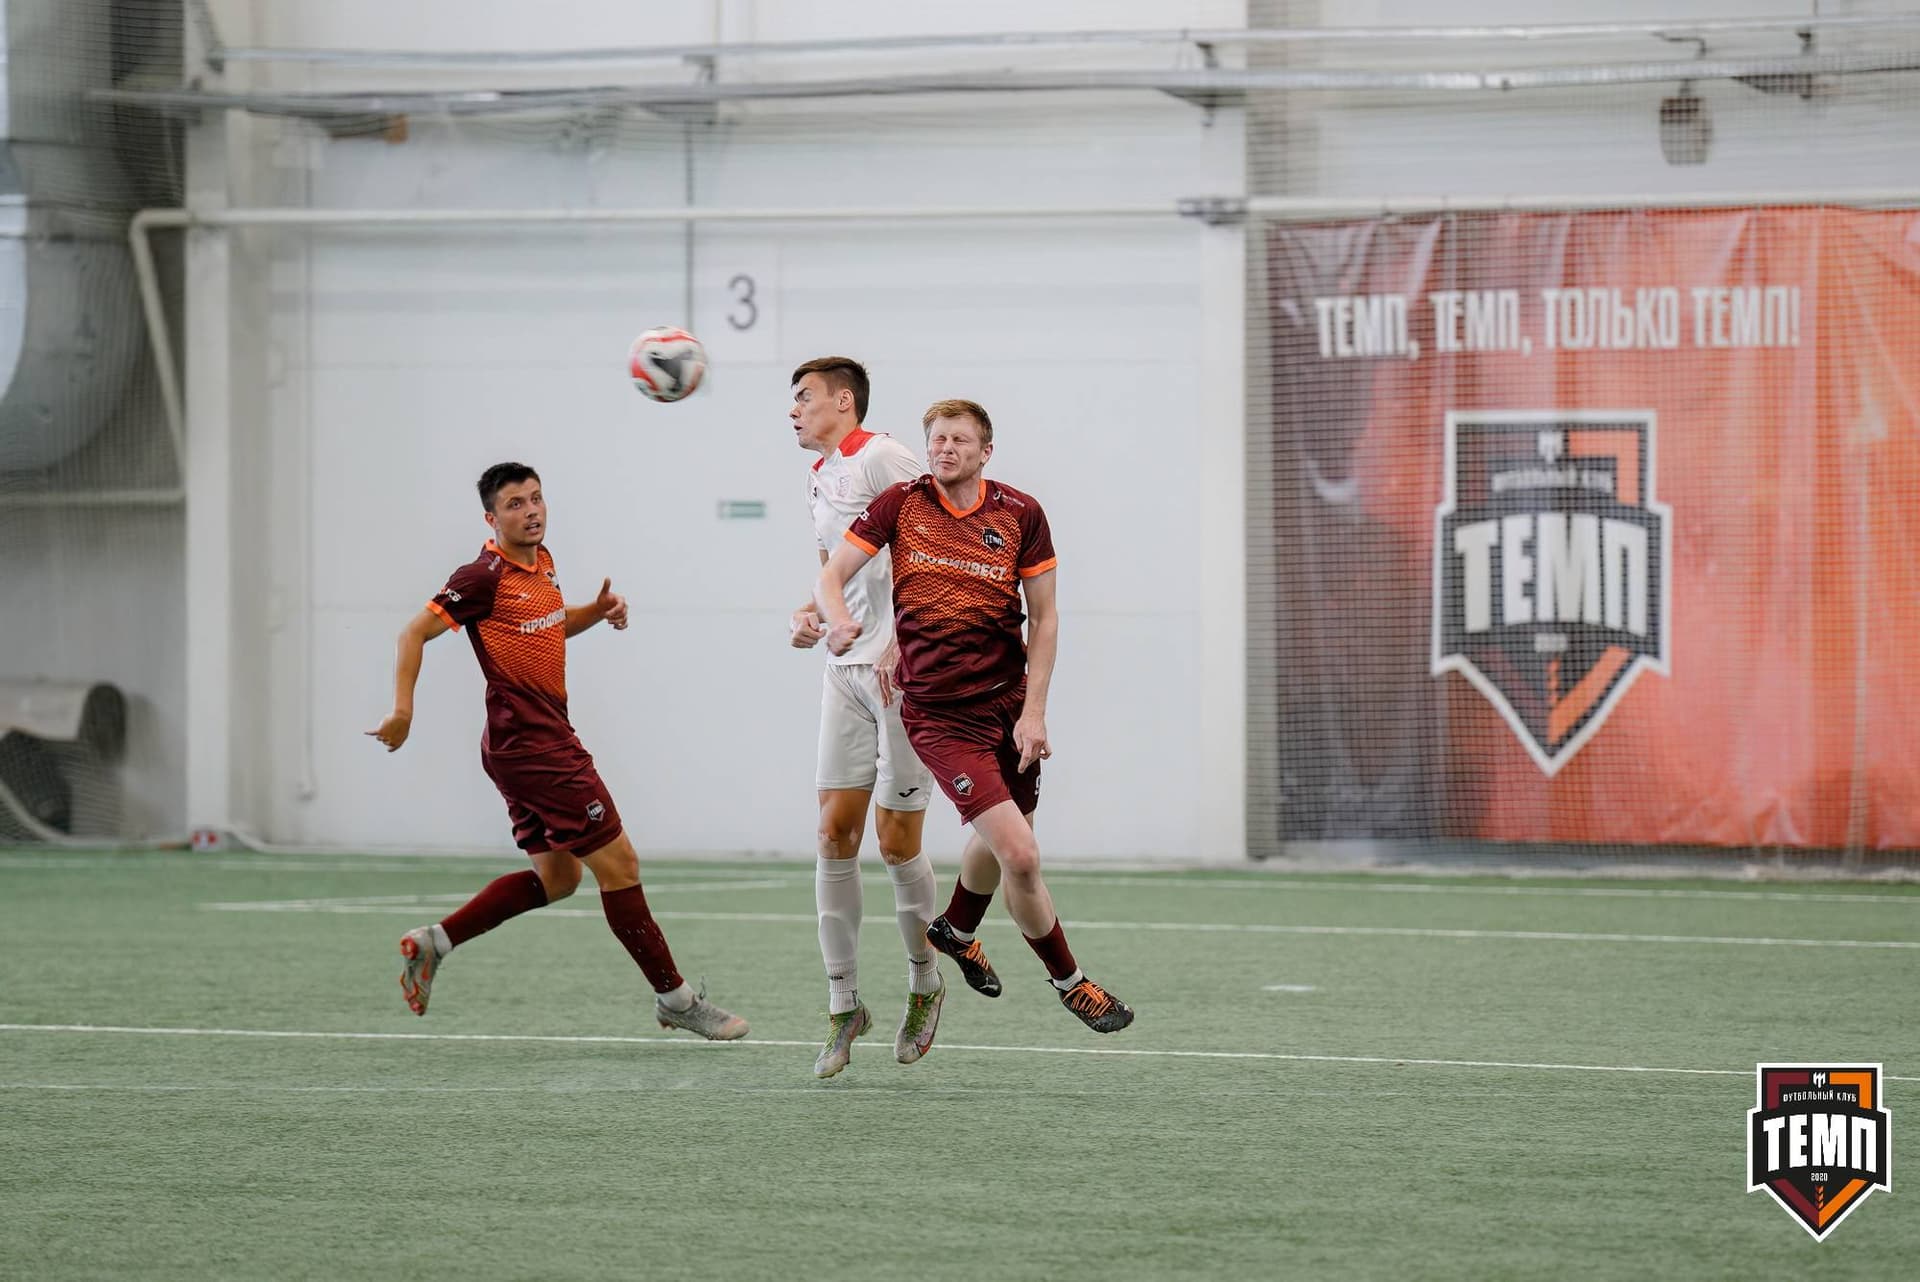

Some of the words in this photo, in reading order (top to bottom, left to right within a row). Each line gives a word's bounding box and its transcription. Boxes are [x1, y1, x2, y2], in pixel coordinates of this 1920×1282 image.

[727, 274, 757, 331] 3
[1315, 293, 1420, 360] ТЕМП,
[1428, 289, 1532, 357] ТЕМП,
[1541, 287, 1680, 349] ТОЛЬКО
[1691, 286, 1800, 348] ТЕМП!
[1454, 512, 1648, 637] ТЕМП
